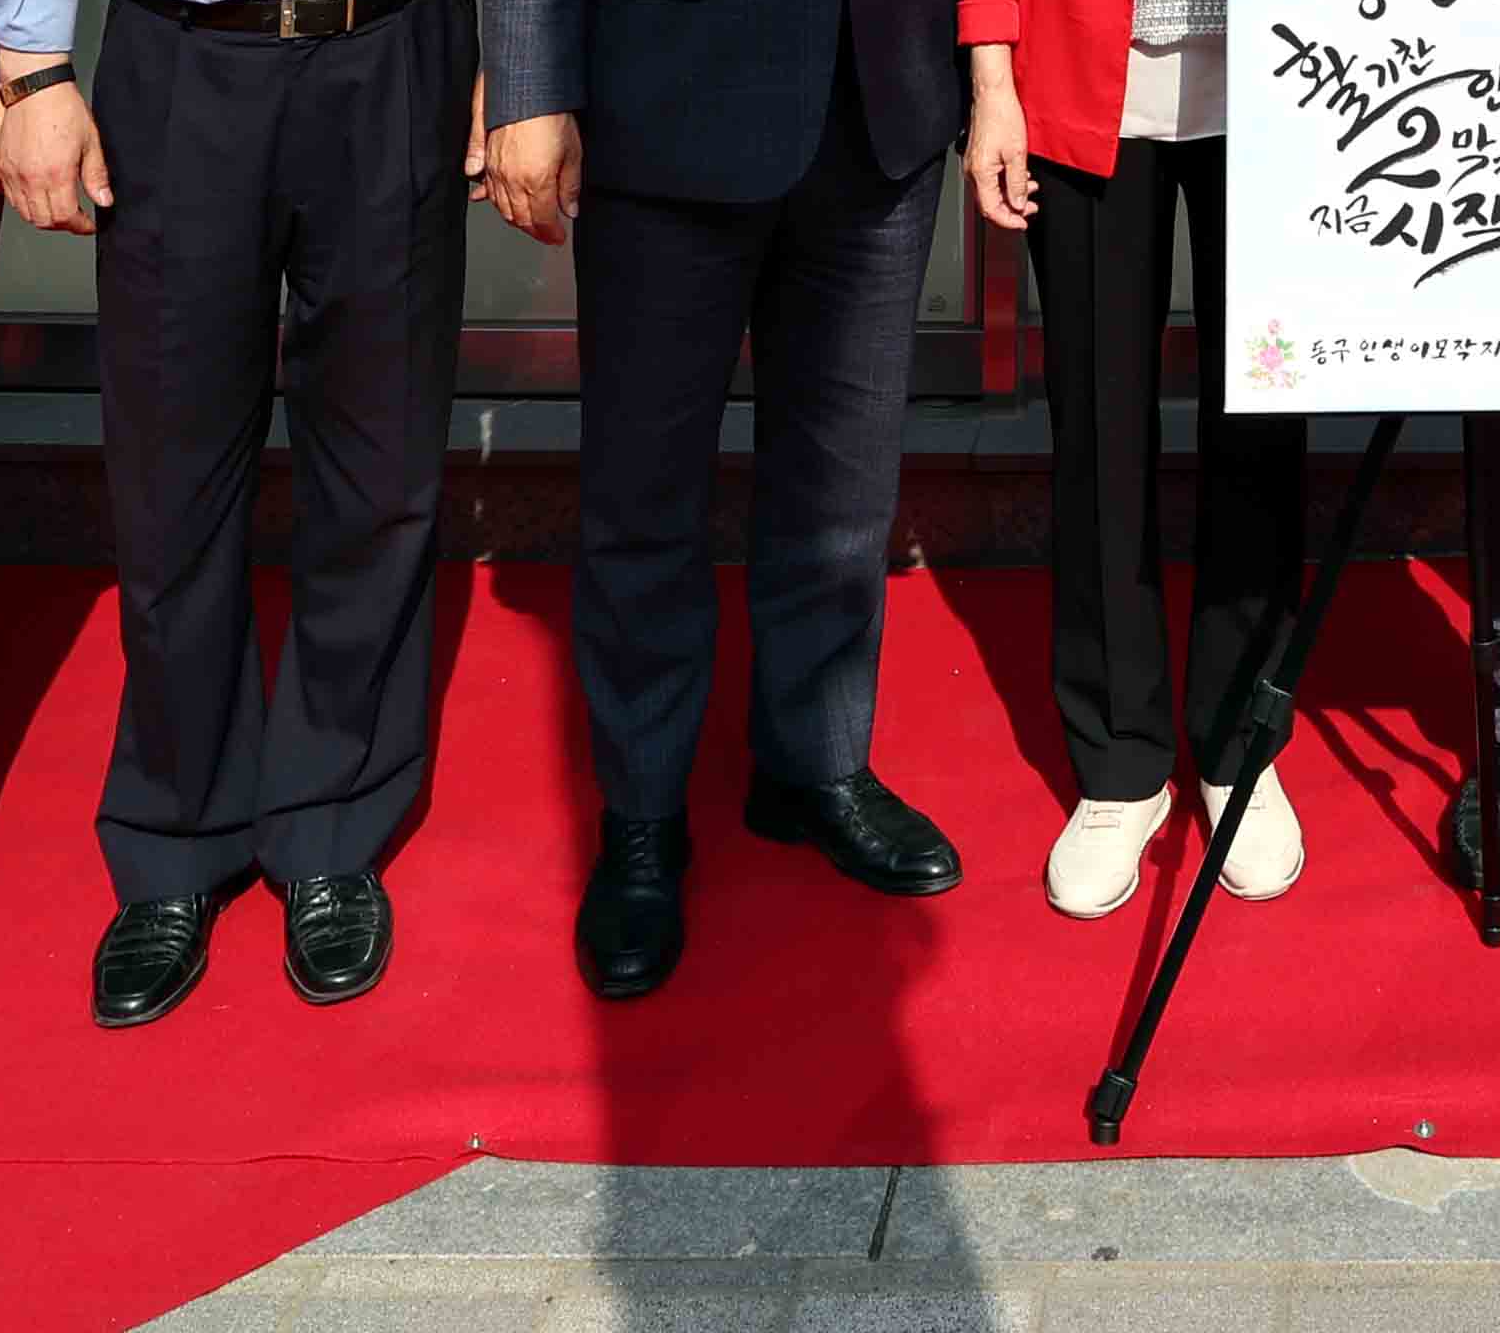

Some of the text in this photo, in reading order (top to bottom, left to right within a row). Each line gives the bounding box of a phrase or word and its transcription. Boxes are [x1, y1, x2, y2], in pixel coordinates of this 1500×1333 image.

[1271, 23, 1436, 152] 활기찬
[1309, 194, 1379, 236] 지금
[1309, 337, 1350, 366] 동구
